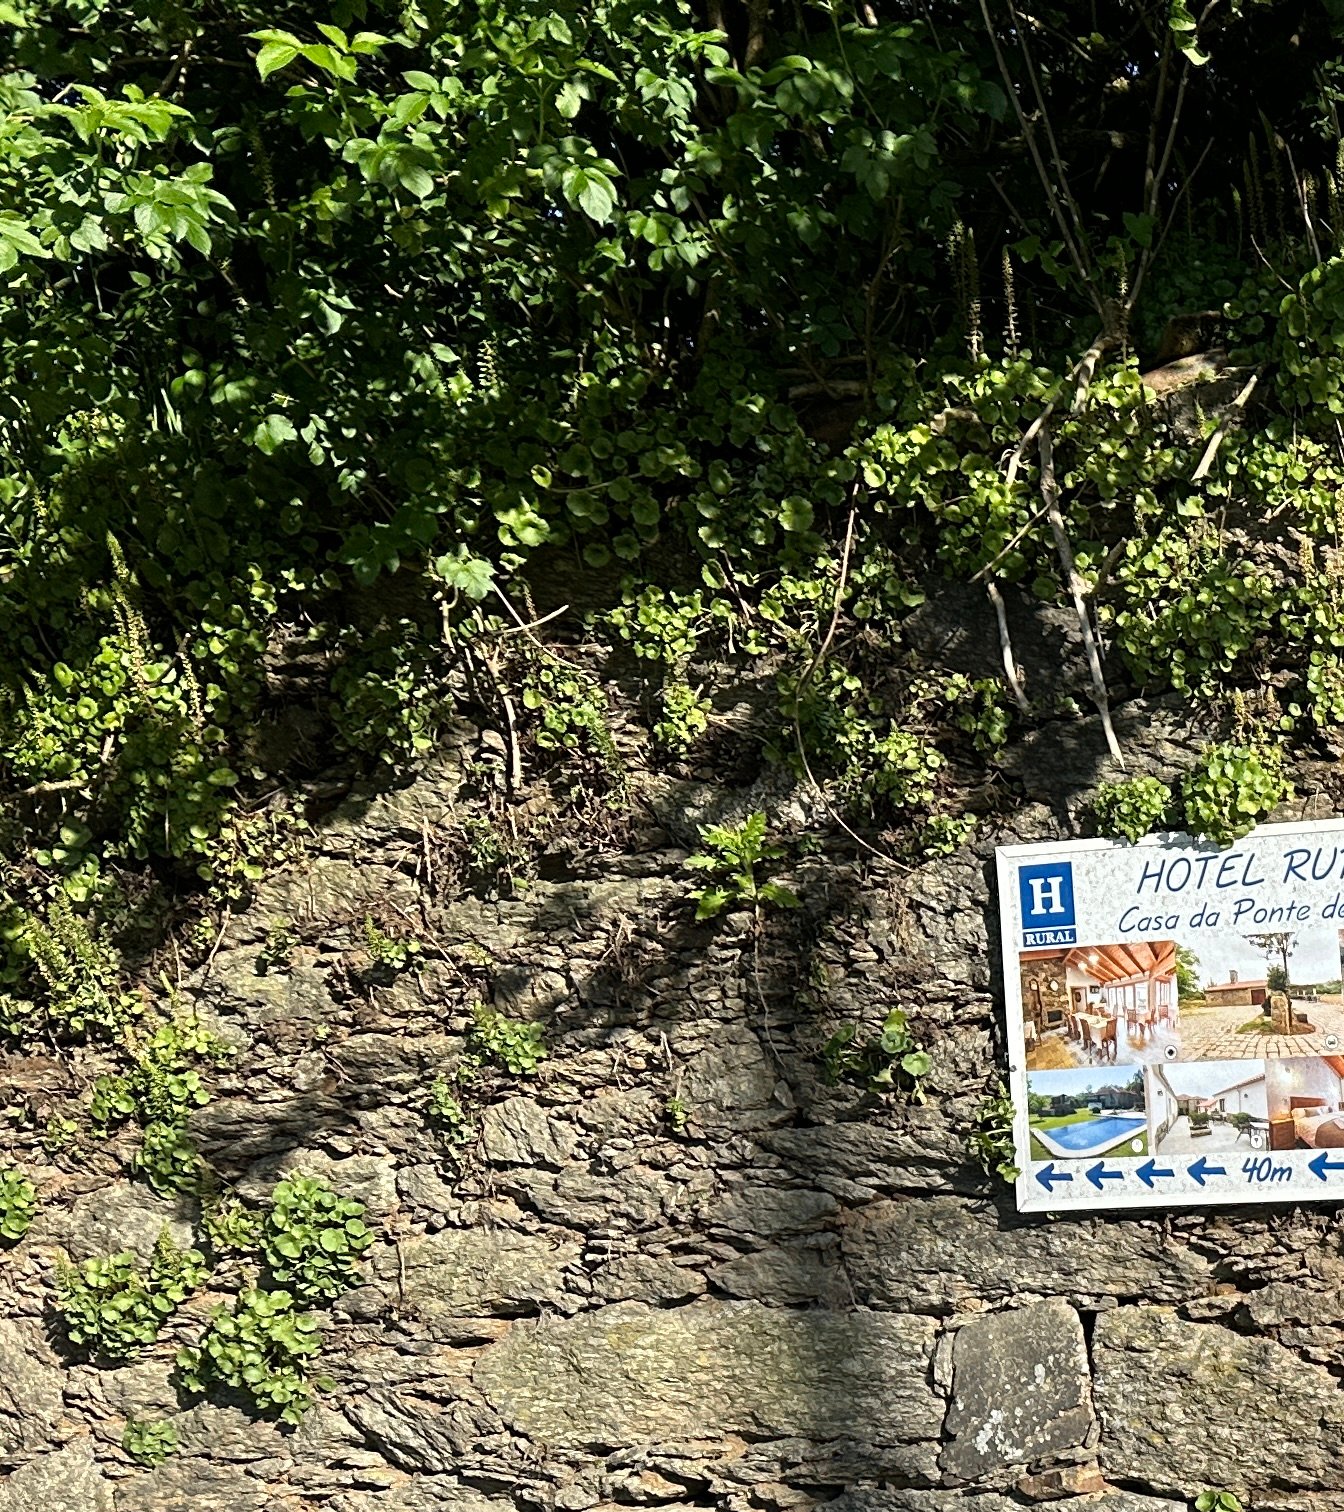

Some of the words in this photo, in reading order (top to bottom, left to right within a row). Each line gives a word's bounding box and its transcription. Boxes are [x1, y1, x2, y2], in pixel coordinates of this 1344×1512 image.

[1136, 853, 1265, 894] HOTEL
[1029, 876, 1065, 916] H
[1118, 908, 1179, 934] Casa
[1190, 903, 1220, 928] da
[1232, 898, 1310, 924] Ponte
[1024, 930, 1074, 946] RURAL
[1242, 1157, 1293, 1182] 40m
